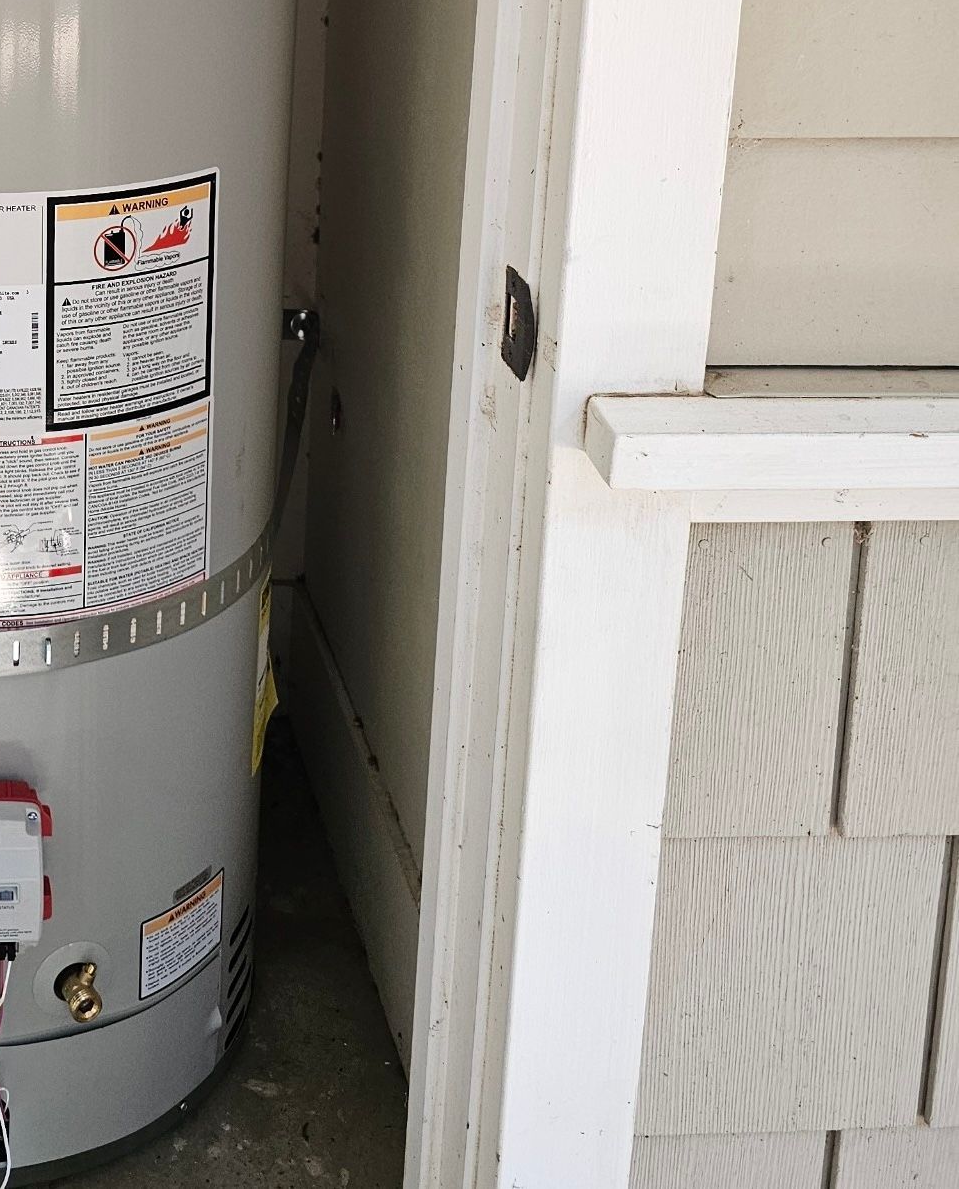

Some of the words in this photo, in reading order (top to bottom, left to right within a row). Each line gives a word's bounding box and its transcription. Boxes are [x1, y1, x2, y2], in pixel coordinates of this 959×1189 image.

[122, 198, 168, 213] WARNING
[136, 256, 164, 266] Flammable
[164, 252, 180, 262] Vapors
[122, 276, 154, 286] EXPLOSION
[155, 271, 177, 280] HAZARD
[146, 418, 171, 430] WARNING
[146, 442, 170, 453] WARNING
[174, 891, 207, 918] WARNING
